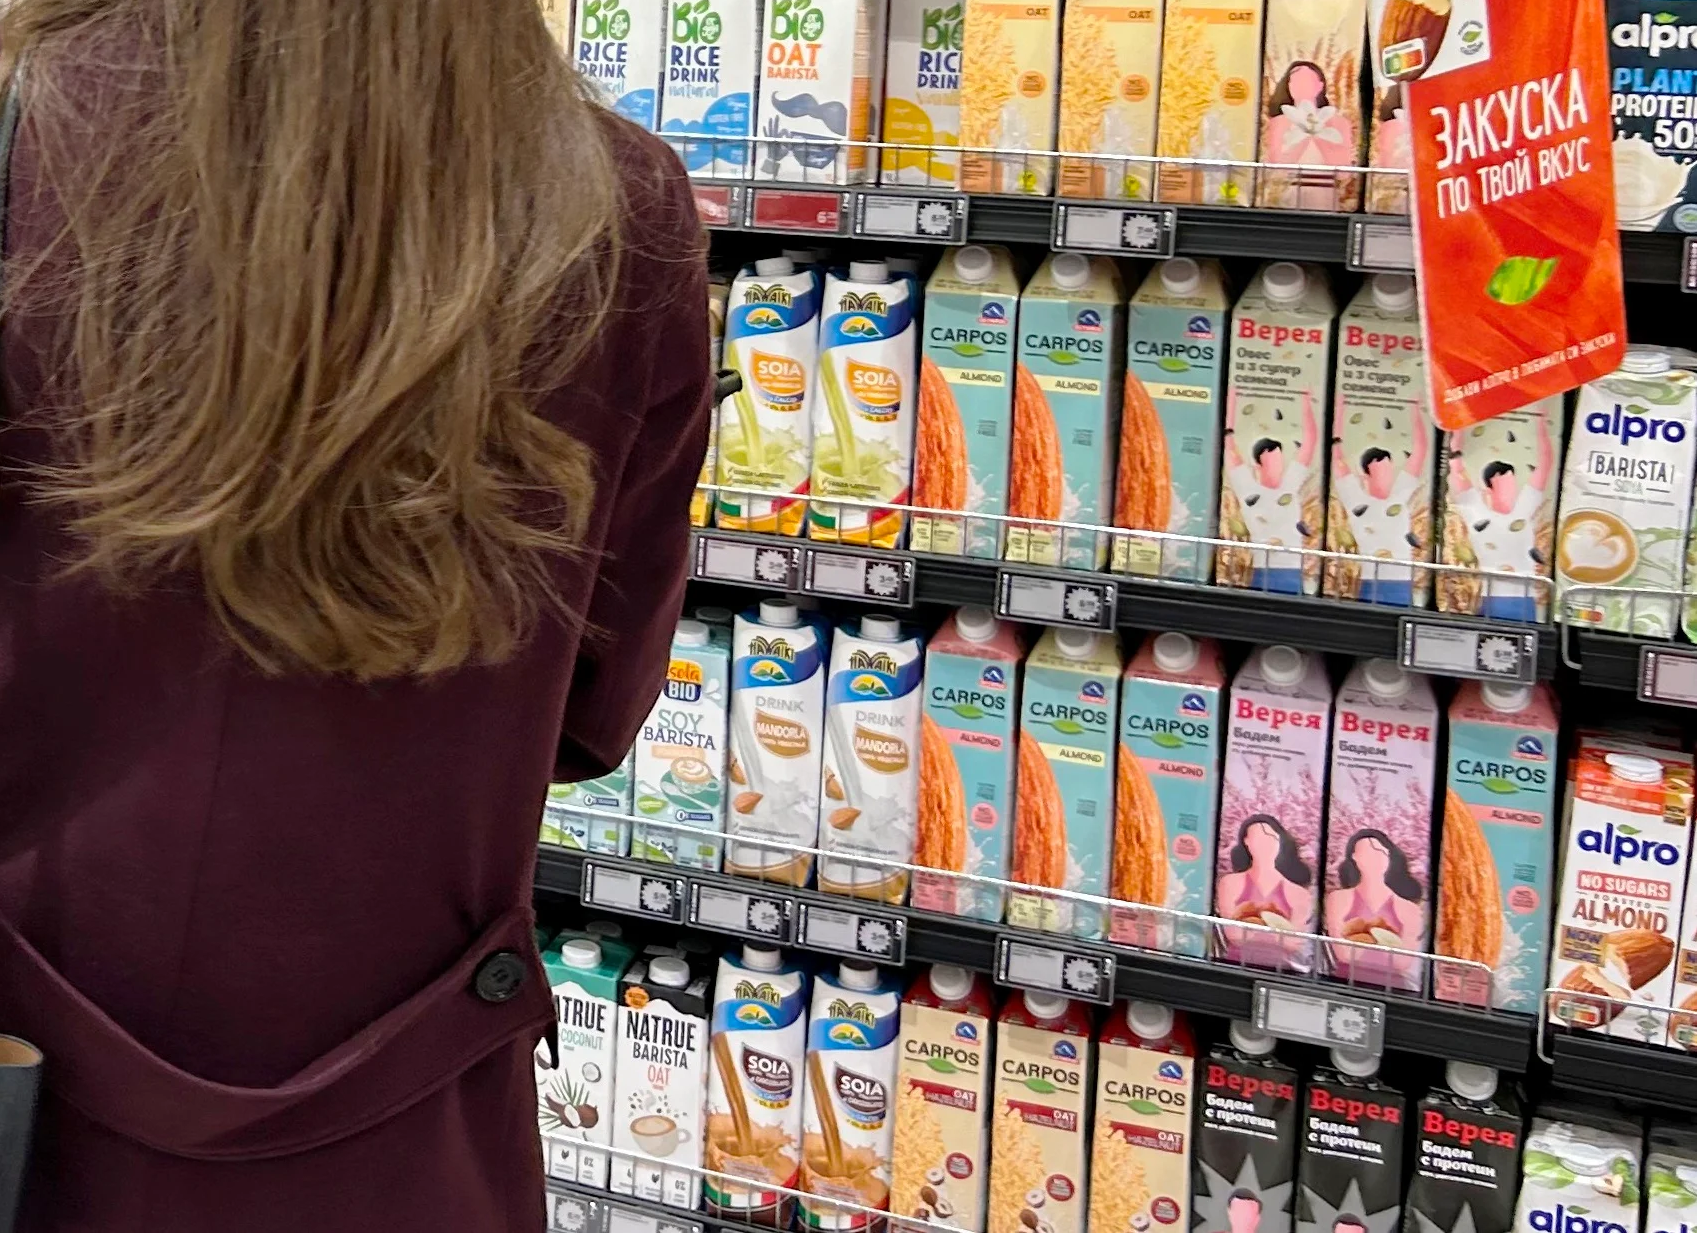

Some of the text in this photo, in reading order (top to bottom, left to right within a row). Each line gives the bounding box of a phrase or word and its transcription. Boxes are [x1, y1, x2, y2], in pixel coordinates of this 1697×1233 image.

[1026, 6, 1049, 18] OAT
[578, 42, 628, 63] RICE
[670, 45, 720, 67] RICE
[767, 43, 823, 67] OAT
[578, 63, 626, 79] DRINK
[669, 67, 720, 83] DRINK
[767, 66, 819, 81] BARISTA
[1431, 67, 1588, 170] ЗАКУСКА
[1437, 136, 1592, 219] ПО ТВОЙ ВКУС
[930, 326, 1007, 346] CARPOS
[1238, 318, 1323, 346] Верея
[1236, 347, 1271, 362] Овес
[758, 359, 801, 378] SOIA
[852, 369, 897, 388] SOIA
[960, 371, 1002, 383] ALMOND
[1258, 363, 1301, 378] супер
[1235, 375, 1288, 388] семена
[1586, 410, 1685, 445] alpro
[1594, 454, 1667, 484] BARISTA
[668, 682, 696, 701] BIO
[932, 686, 1006, 709] CARPOS
[755, 696, 804, 713] DRINK
[1235, 698, 1322, 730] Верея
[658, 710, 704, 732] SOY
[757, 722, 806, 740] MANDORLA
[1341, 711, 1430, 743] Верея
[643, 726, 716, 751] BARISTA
[1233, 726, 1281, 745] Бадем
[1456, 759, 1547, 785] CARPOS
[1491, 809, 1542, 825] ALMOND
[1577, 823, 1680, 866] alpro
[1580, 874, 1669, 898] NO SUGARS
[1594, 893, 1652, 910] ROASTED
[1572, 898, 1668, 934] ALMOND
[626, 1010, 697, 1051] NATRUE
[632, 1040, 689, 1069] BARISTA
[748, 1055, 791, 1076] SOIA
[647, 1064, 671, 1086] OAT
[1105, 1079, 1187, 1107] CARPOS
[1157, 1130, 1183, 1145] OAT
[1423, 1110, 1516, 1149] Верея
[1421, 1140, 1473, 1160] Бадем
[1434, 1157, 1497, 1179] протеин
